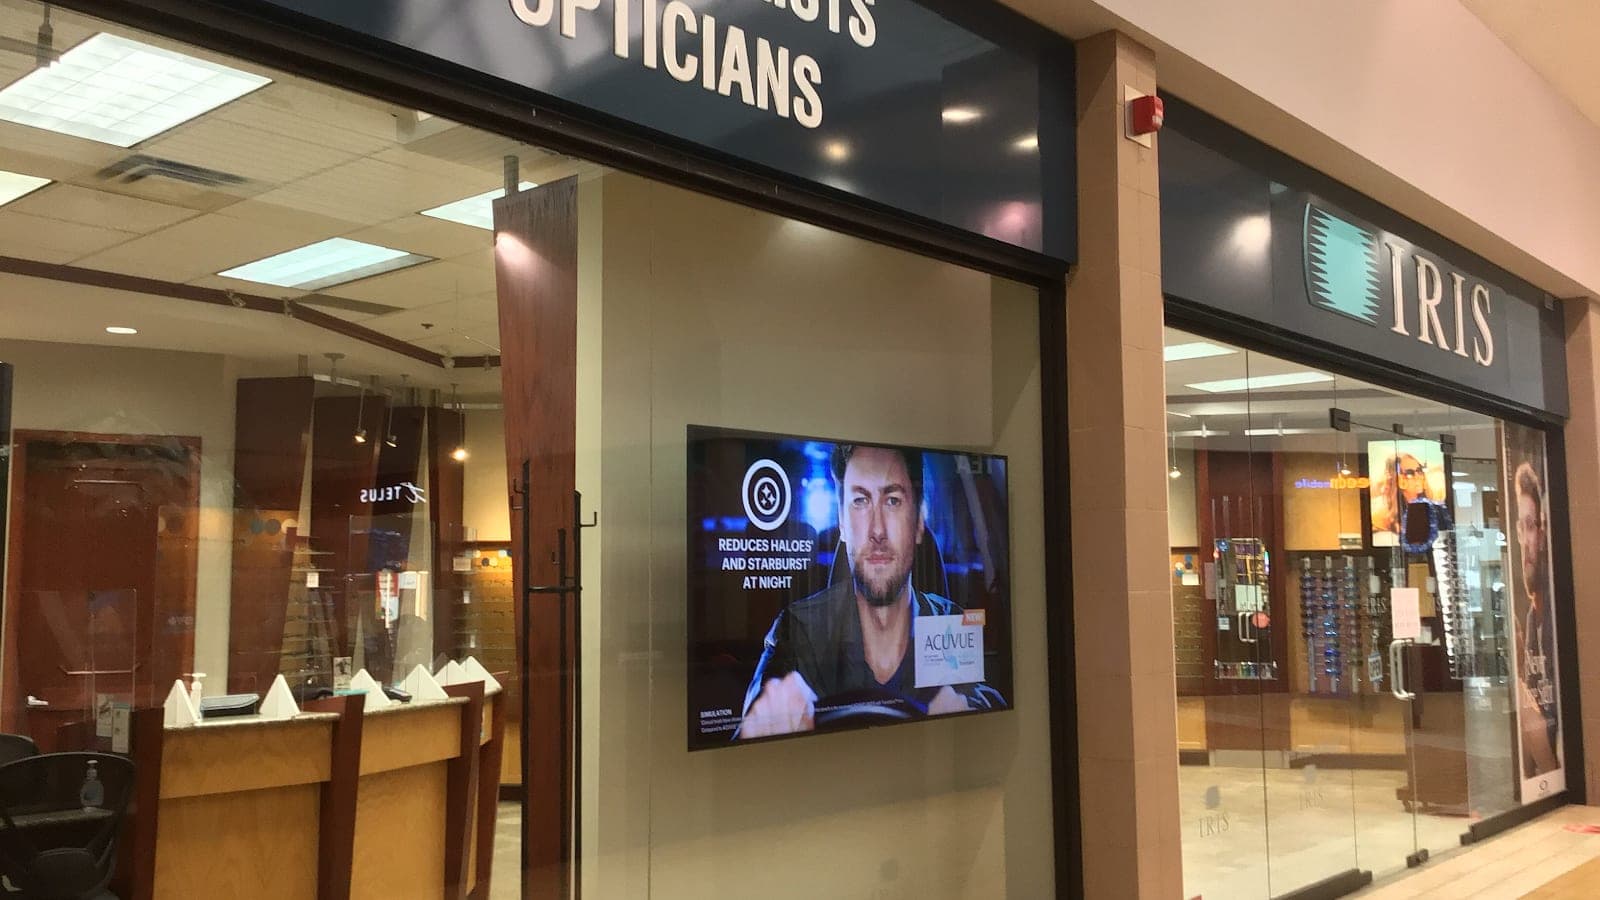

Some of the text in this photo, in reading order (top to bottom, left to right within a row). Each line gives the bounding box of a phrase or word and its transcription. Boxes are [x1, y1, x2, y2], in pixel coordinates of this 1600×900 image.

[1384, 242, 1494, 367] IRIS
[718, 538, 769, 552] REDUCES
[721, 557, 746, 571] AND
[742, 576, 793, 589] AT NIGHT
[924, 632, 975, 651] ACUVUE
[1198, 811, 1230, 838] IRIS
